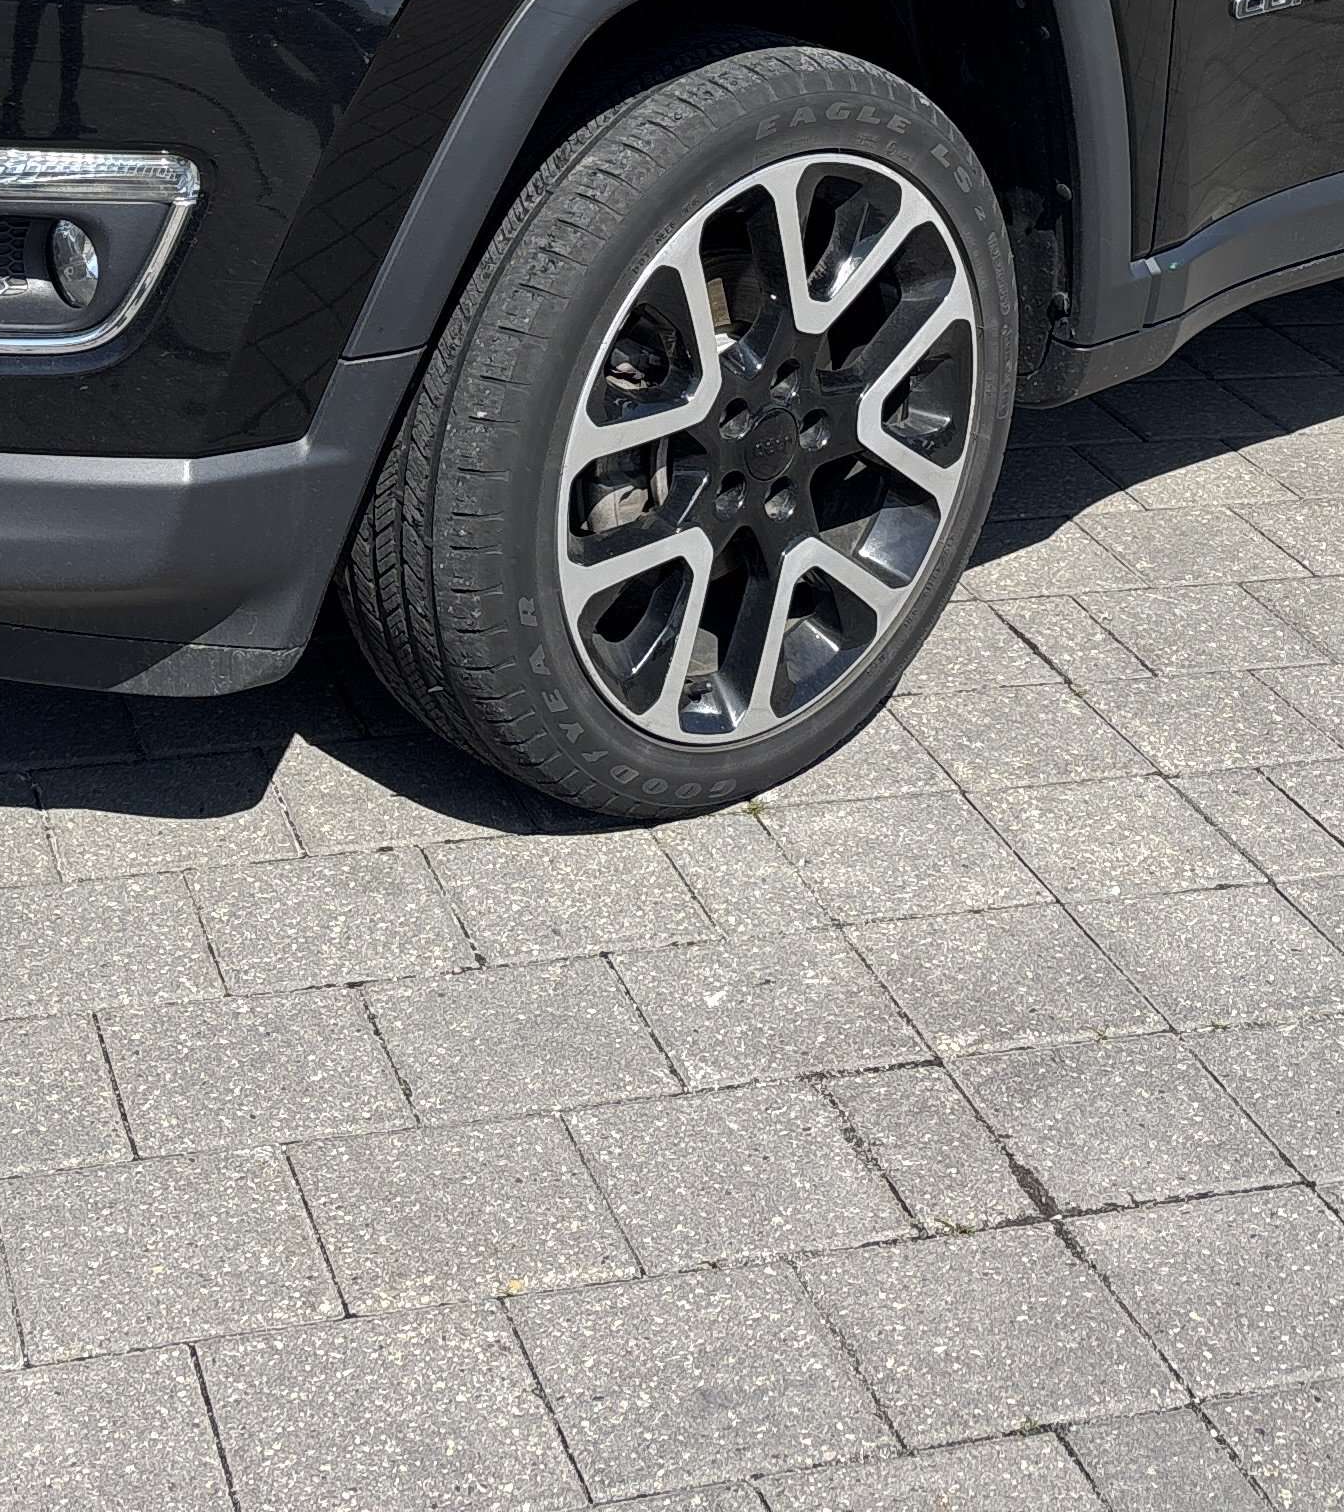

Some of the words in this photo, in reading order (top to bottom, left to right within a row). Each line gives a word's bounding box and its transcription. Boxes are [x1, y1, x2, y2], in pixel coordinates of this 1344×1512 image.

[756, 101, 912, 140] EAGLE
[930, 143, 973, 193] LS
[518, 596, 738, 800] GOODYEAR
